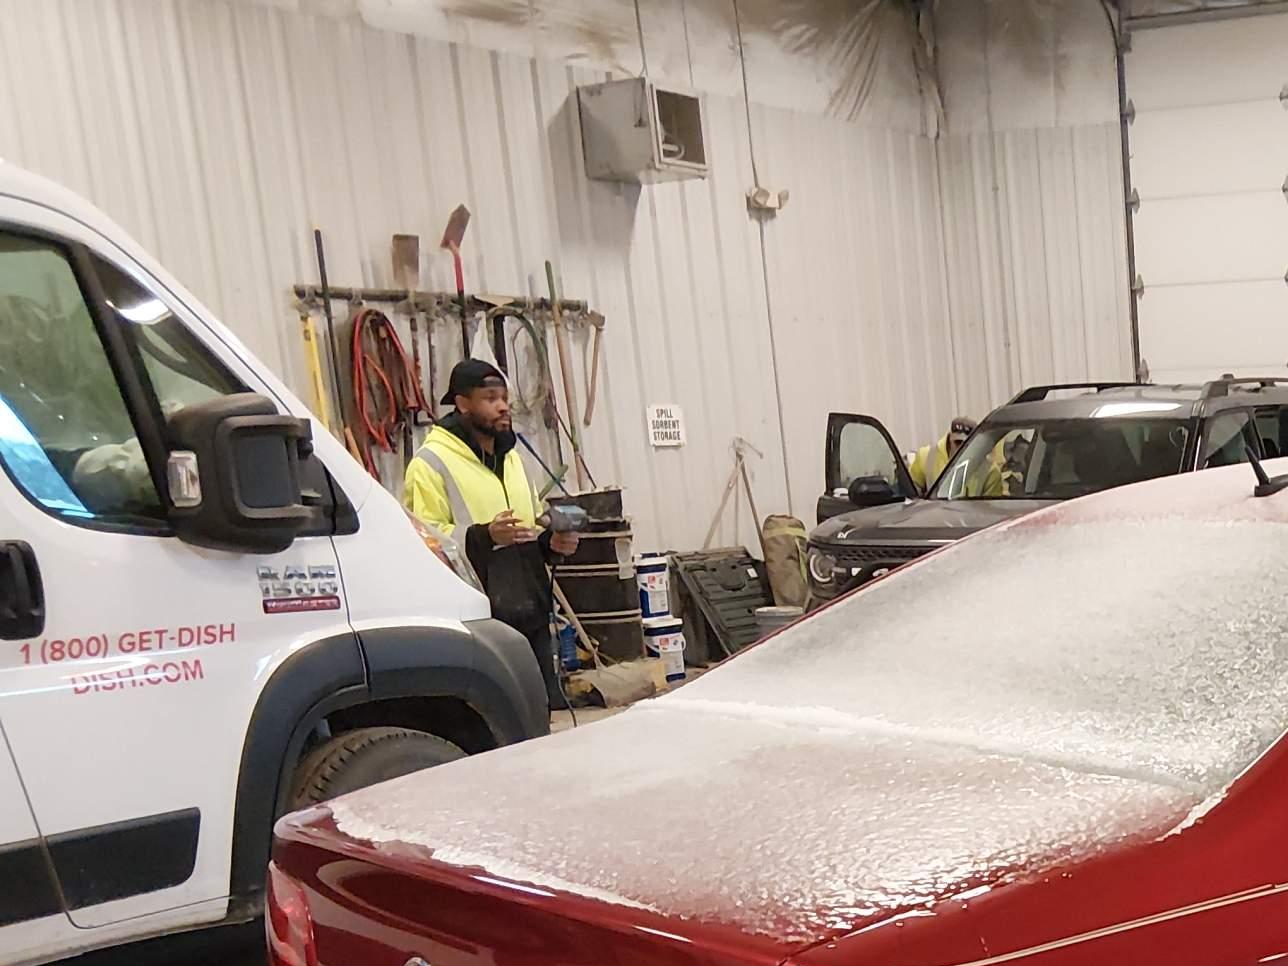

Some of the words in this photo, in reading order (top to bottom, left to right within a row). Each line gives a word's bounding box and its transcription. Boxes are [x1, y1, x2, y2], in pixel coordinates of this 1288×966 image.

[655, 408, 673, 418] SPILL
[652, 419, 680, 430] SORBENT
[653, 430, 680, 441] STORAGE
[20, 643, 31, 664] 1
[40, 633, 108, 664] (800)
[118, 623, 236, 654] GET-DISH
[70, 659, 204, 695] DISH.COM
